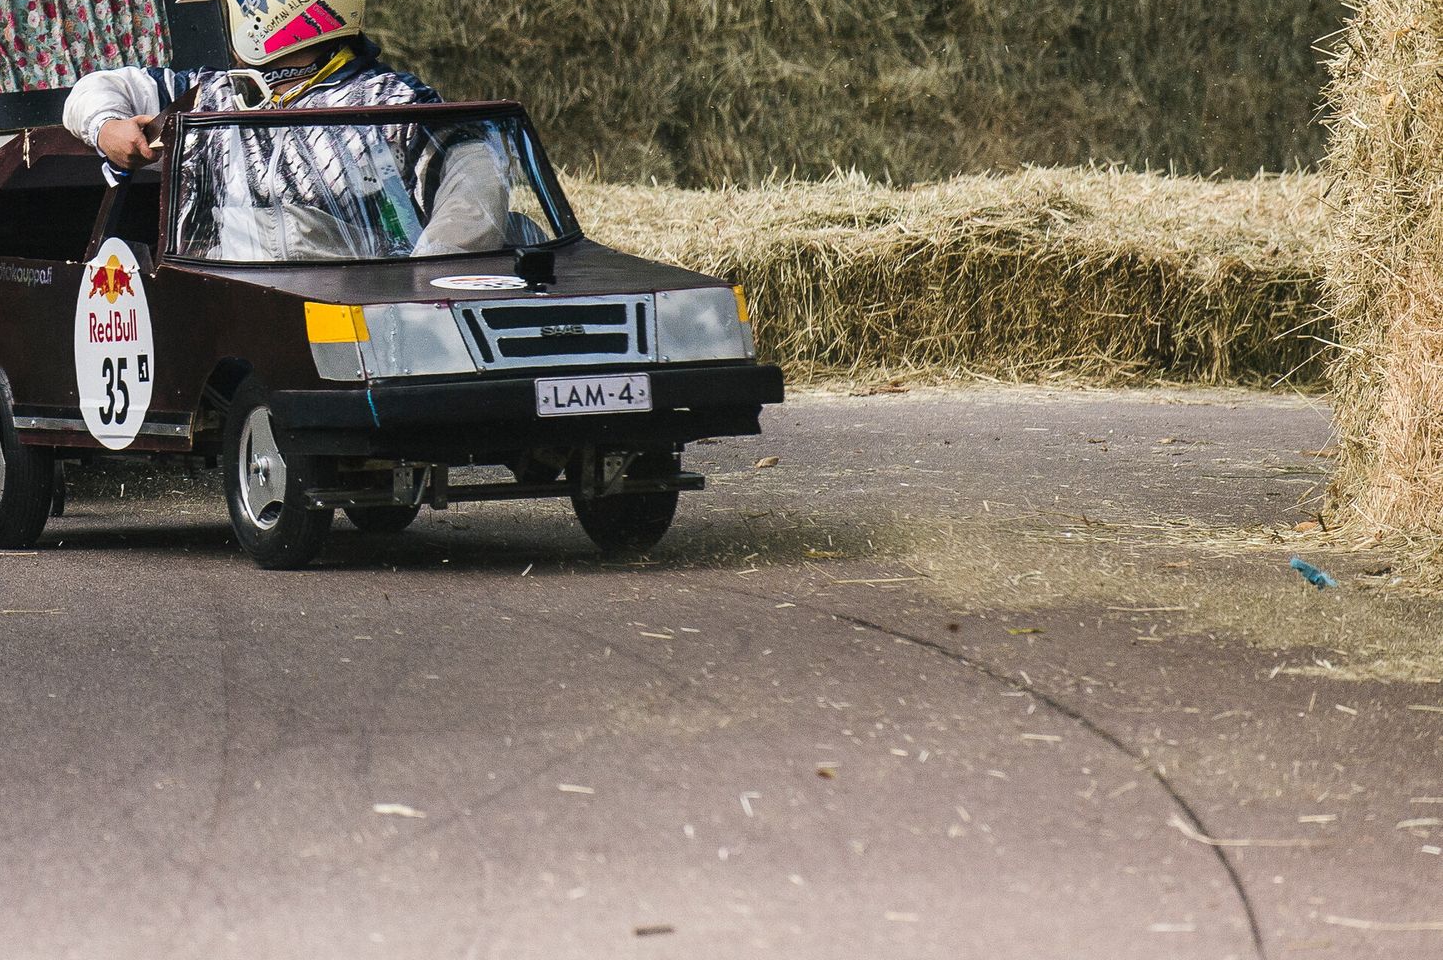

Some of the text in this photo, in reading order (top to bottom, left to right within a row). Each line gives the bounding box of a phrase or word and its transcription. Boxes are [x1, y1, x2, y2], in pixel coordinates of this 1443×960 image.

[263, 63, 318, 83] CARRERA
[89, 309, 138, 343] Red Bull
[541, 324, 586, 336] SAAB
[98, 357, 131, 426] 35
[552, 382, 635, 409] LAM-4
